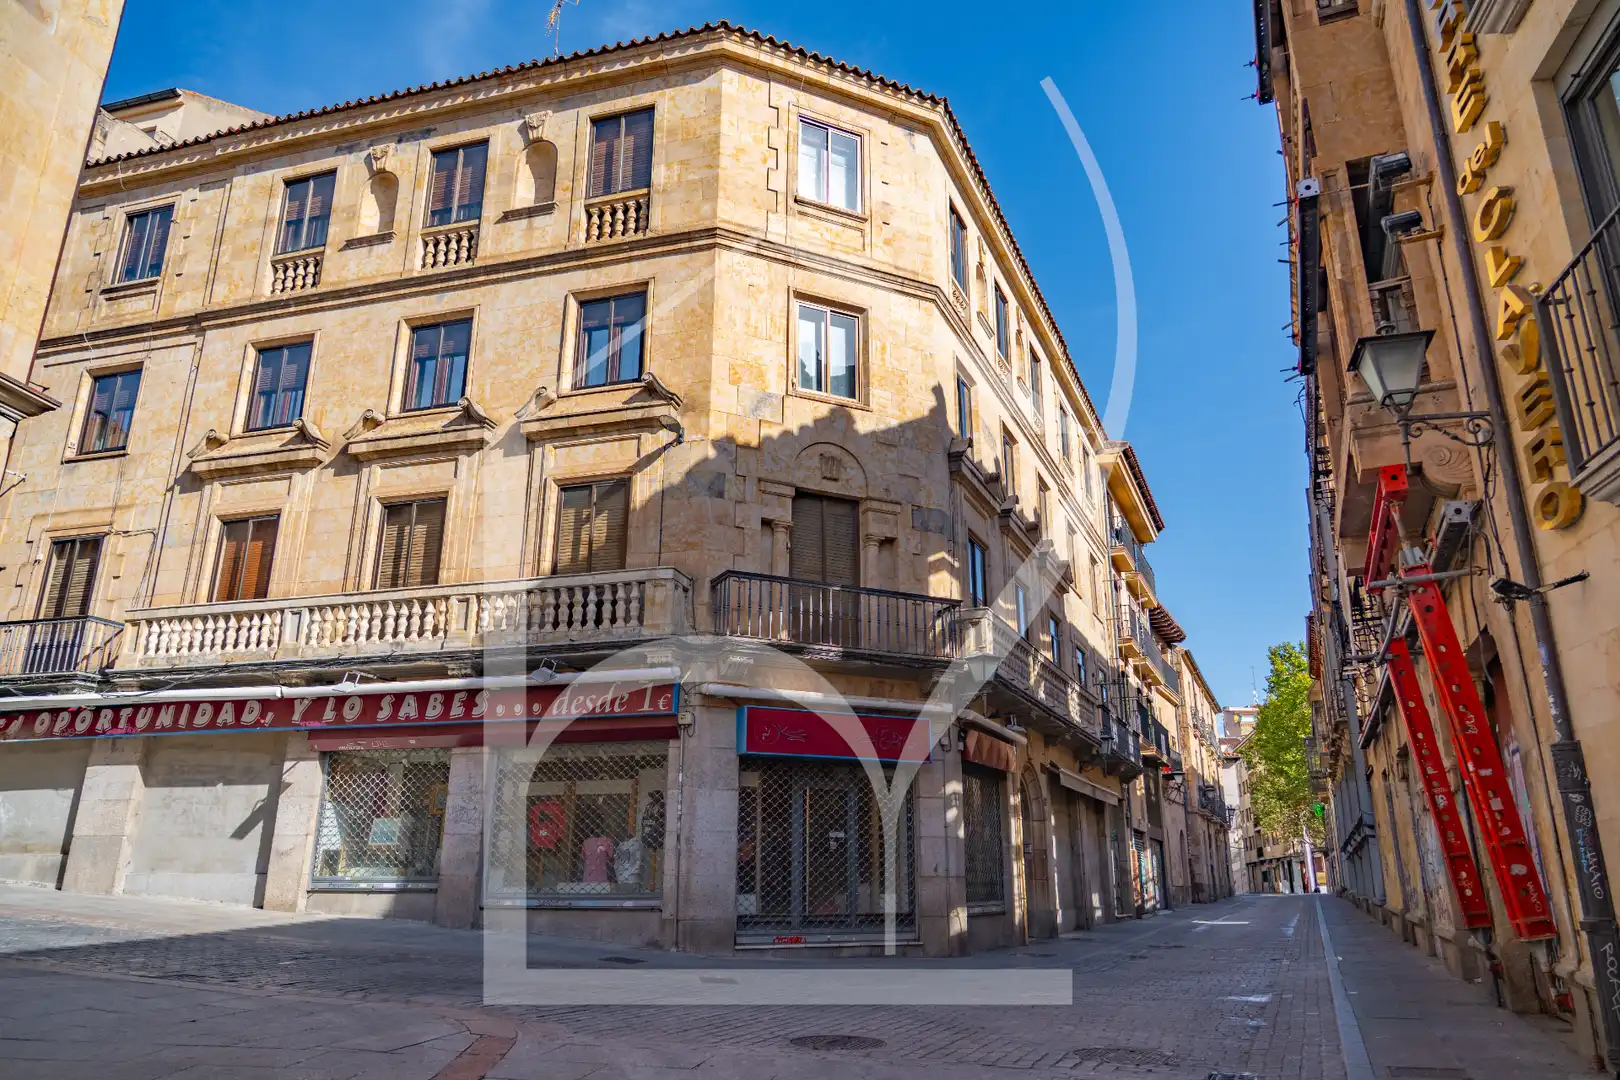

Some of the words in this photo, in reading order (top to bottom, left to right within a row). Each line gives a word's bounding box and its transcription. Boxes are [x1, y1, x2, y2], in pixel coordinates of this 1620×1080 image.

[1425, 0, 1486, 134] RRE
[1457, 120, 1504, 196] del
[34, 699, 275, 737] OPORTUNIDAD,
[291, 696, 317, 723] Y
[322, 695, 363, 722] LO
[552, 681, 630, 716] desde
